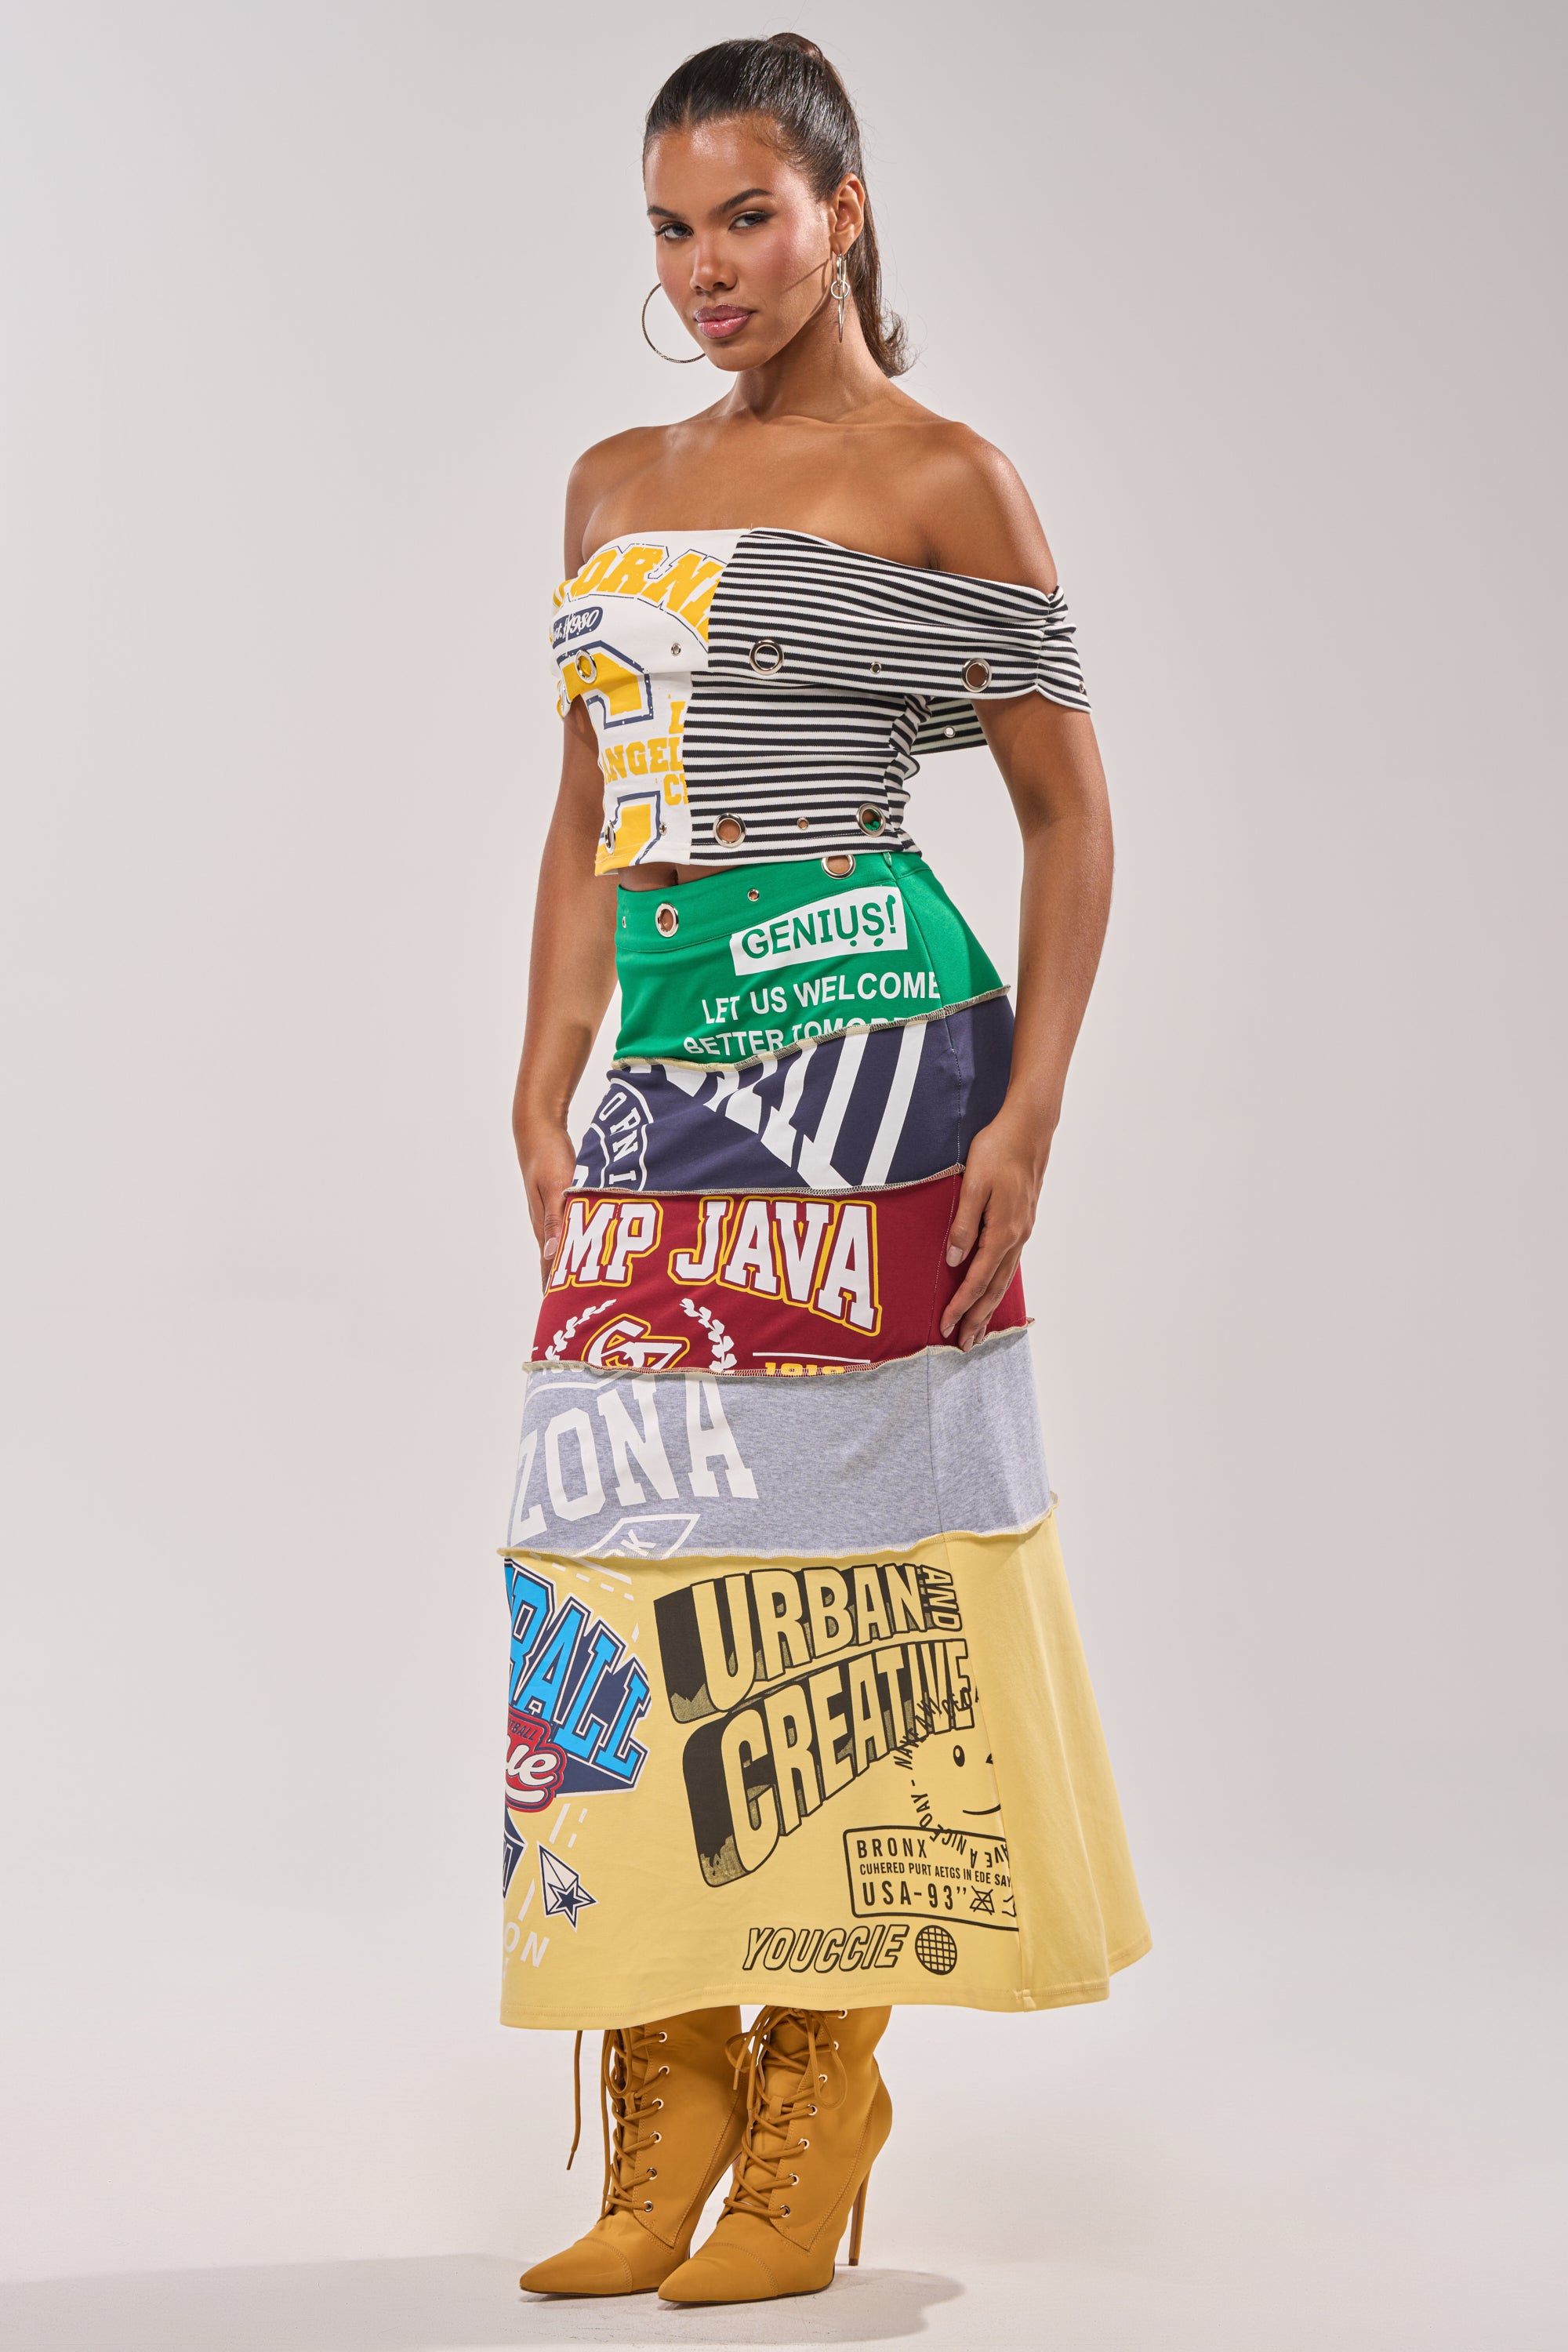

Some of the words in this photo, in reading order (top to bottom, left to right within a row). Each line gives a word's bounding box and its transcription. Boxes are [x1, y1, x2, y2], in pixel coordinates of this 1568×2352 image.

[741, 894, 897, 960] GENIUS!
[702, 995, 740, 1025] LET
[750, 985, 786, 1014] US
[793, 971, 941, 1008] WELCOME
[683, 1029, 784, 1056] BETTER
[668, 1196, 882, 1336] JAVA
[508, 1374, 760, 1548] ZONA
[657, 1563, 926, 1721] URBAN
[920, 1564, 962, 1632] AND
[684, 1638, 975, 1887] CREATIVE
[856, 1837, 927, 1859] BRONX
[859, 1861, 906, 1875] CUHERED
[909, 1863, 931, 1876] PURT
[935, 1866, 960, 1879] AETGS
[963, 1868, 971, 1881] IN
[975, 1871, 991, 1884] EDE
[742, 1924, 910, 1973] YOUCCIE
